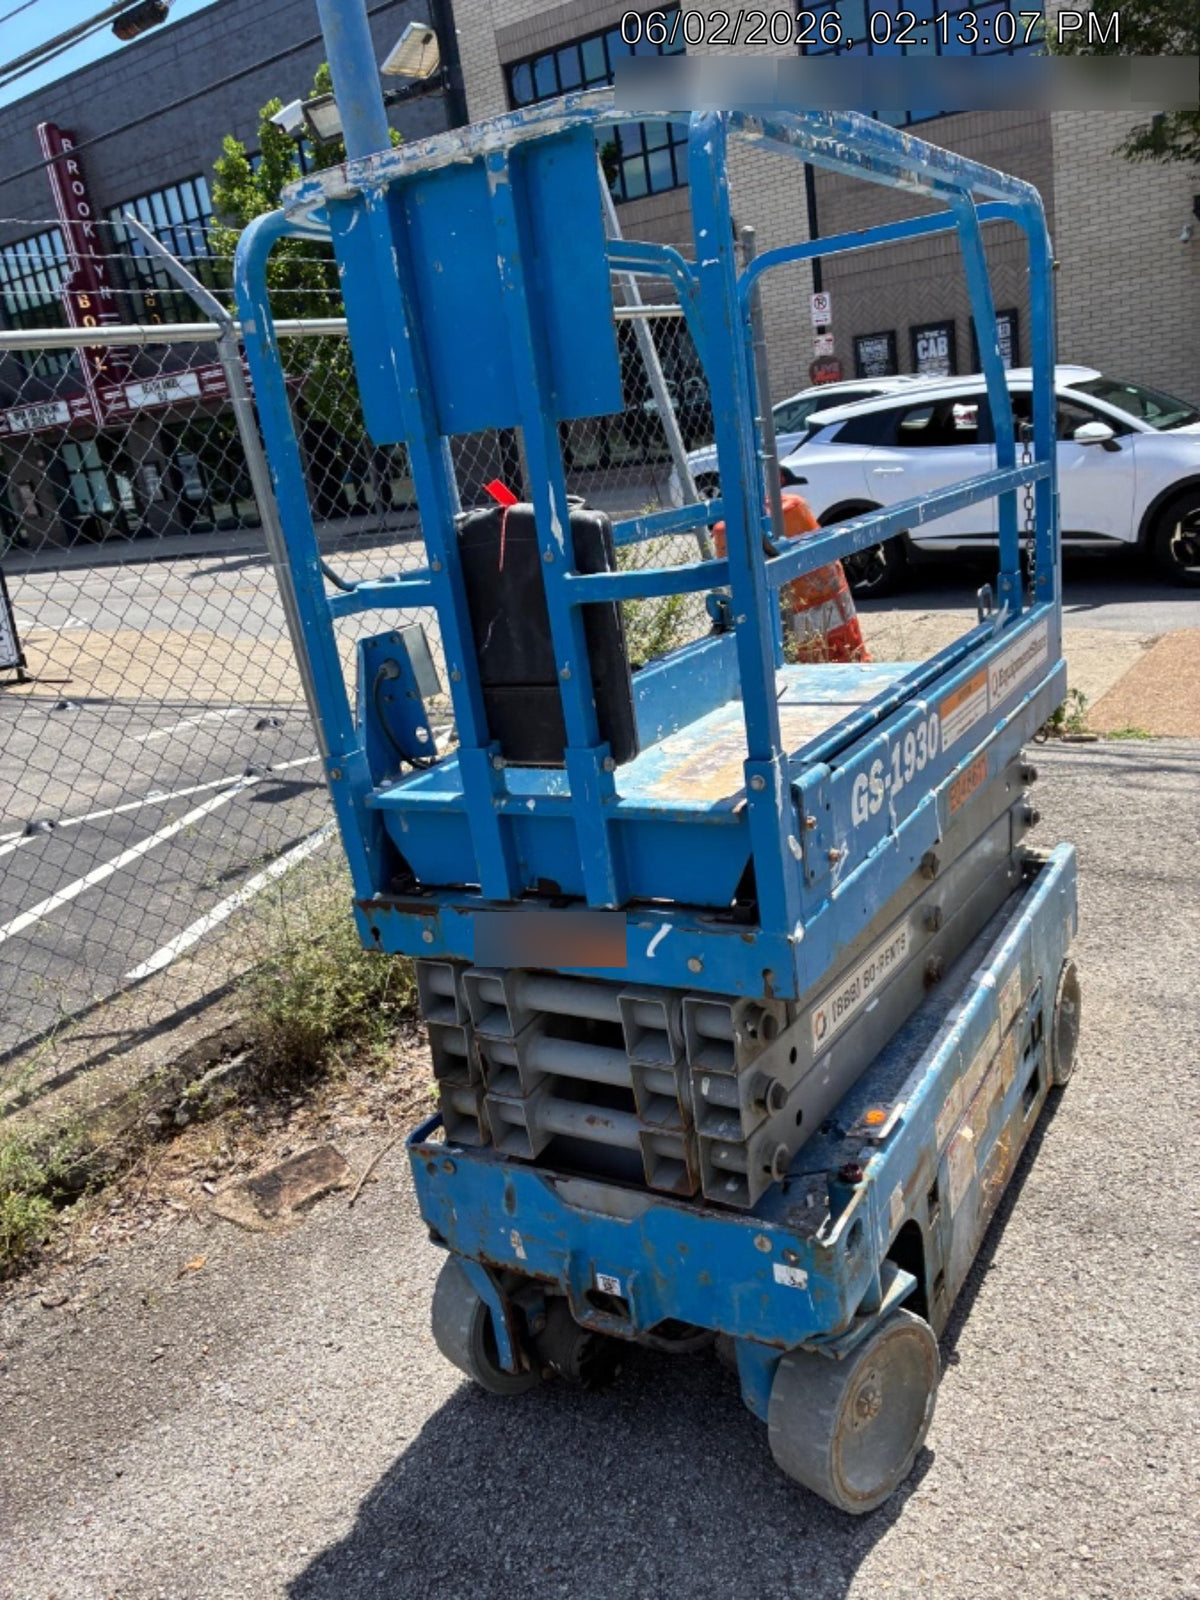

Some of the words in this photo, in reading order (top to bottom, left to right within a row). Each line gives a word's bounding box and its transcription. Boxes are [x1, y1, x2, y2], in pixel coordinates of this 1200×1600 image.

[61, 138, 112, 301] BROOKLYN
[917, 337, 949, 360] CAB
[852, 713, 939, 827] GS-1930
